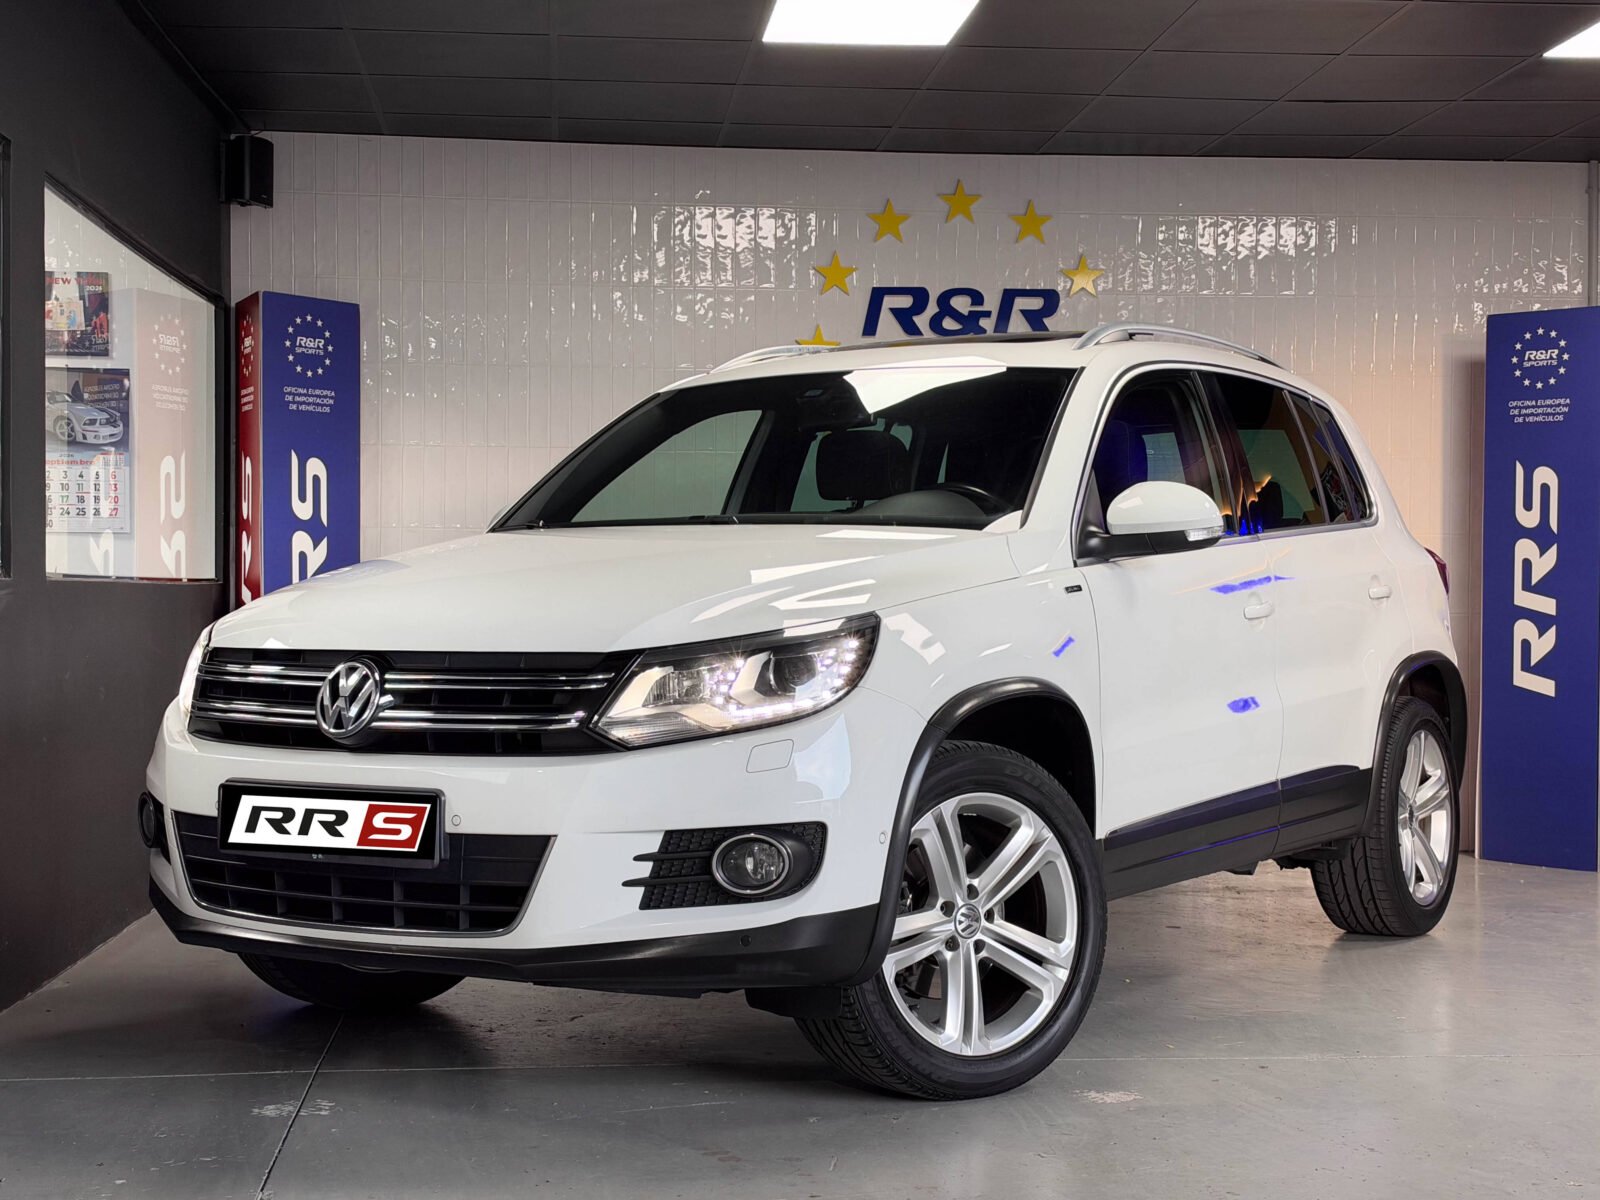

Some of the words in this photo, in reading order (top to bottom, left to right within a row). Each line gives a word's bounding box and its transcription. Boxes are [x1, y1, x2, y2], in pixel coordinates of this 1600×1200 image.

[862, 286, 1060, 337] R&R
[296, 336, 325, 349] R&R
[295, 346, 324, 356] SPORTS
[1524, 349, 1559, 361] R&R
[1523, 359, 1558, 368] SPORTS
[283, 386, 307, 395] OFICINA
[308, 387, 335, 397] EUROPEA
[294, 395, 334, 405] IMPORTACIÓN
[1508, 399, 1536, 408] OFICINA
[1537, 398, 1571, 406] EUROPEA
[298, 404, 331, 413] VEHÍCULOS
[1509, 408, 1519, 416] DE
[1520, 405, 1569, 415] IMPORTACIÓN
[1525, 414, 1564, 423] VEHÍCULOS
[62, 471, 68, 479] 3
[78, 471, 84, 479] 4
[95, 471, 100, 480] 5
[111, 470, 117, 479] 6
[60, 483, 70, 491] 10
[77, 483, 84, 491] 11
[93, 483, 101, 491] 12
[109, 483, 118, 492] 13
[60, 495, 70, 503] 17
[76, 495, 86, 504] 18
[93, 495, 101, 503] 19
[109, 495, 119, 504] 20
[60, 507, 71, 516] 24
[76, 507, 86, 516] 25
[92, 507, 101, 516] 26
[108, 507, 119, 516] 27
[1513, 459, 1559, 698] RRS
